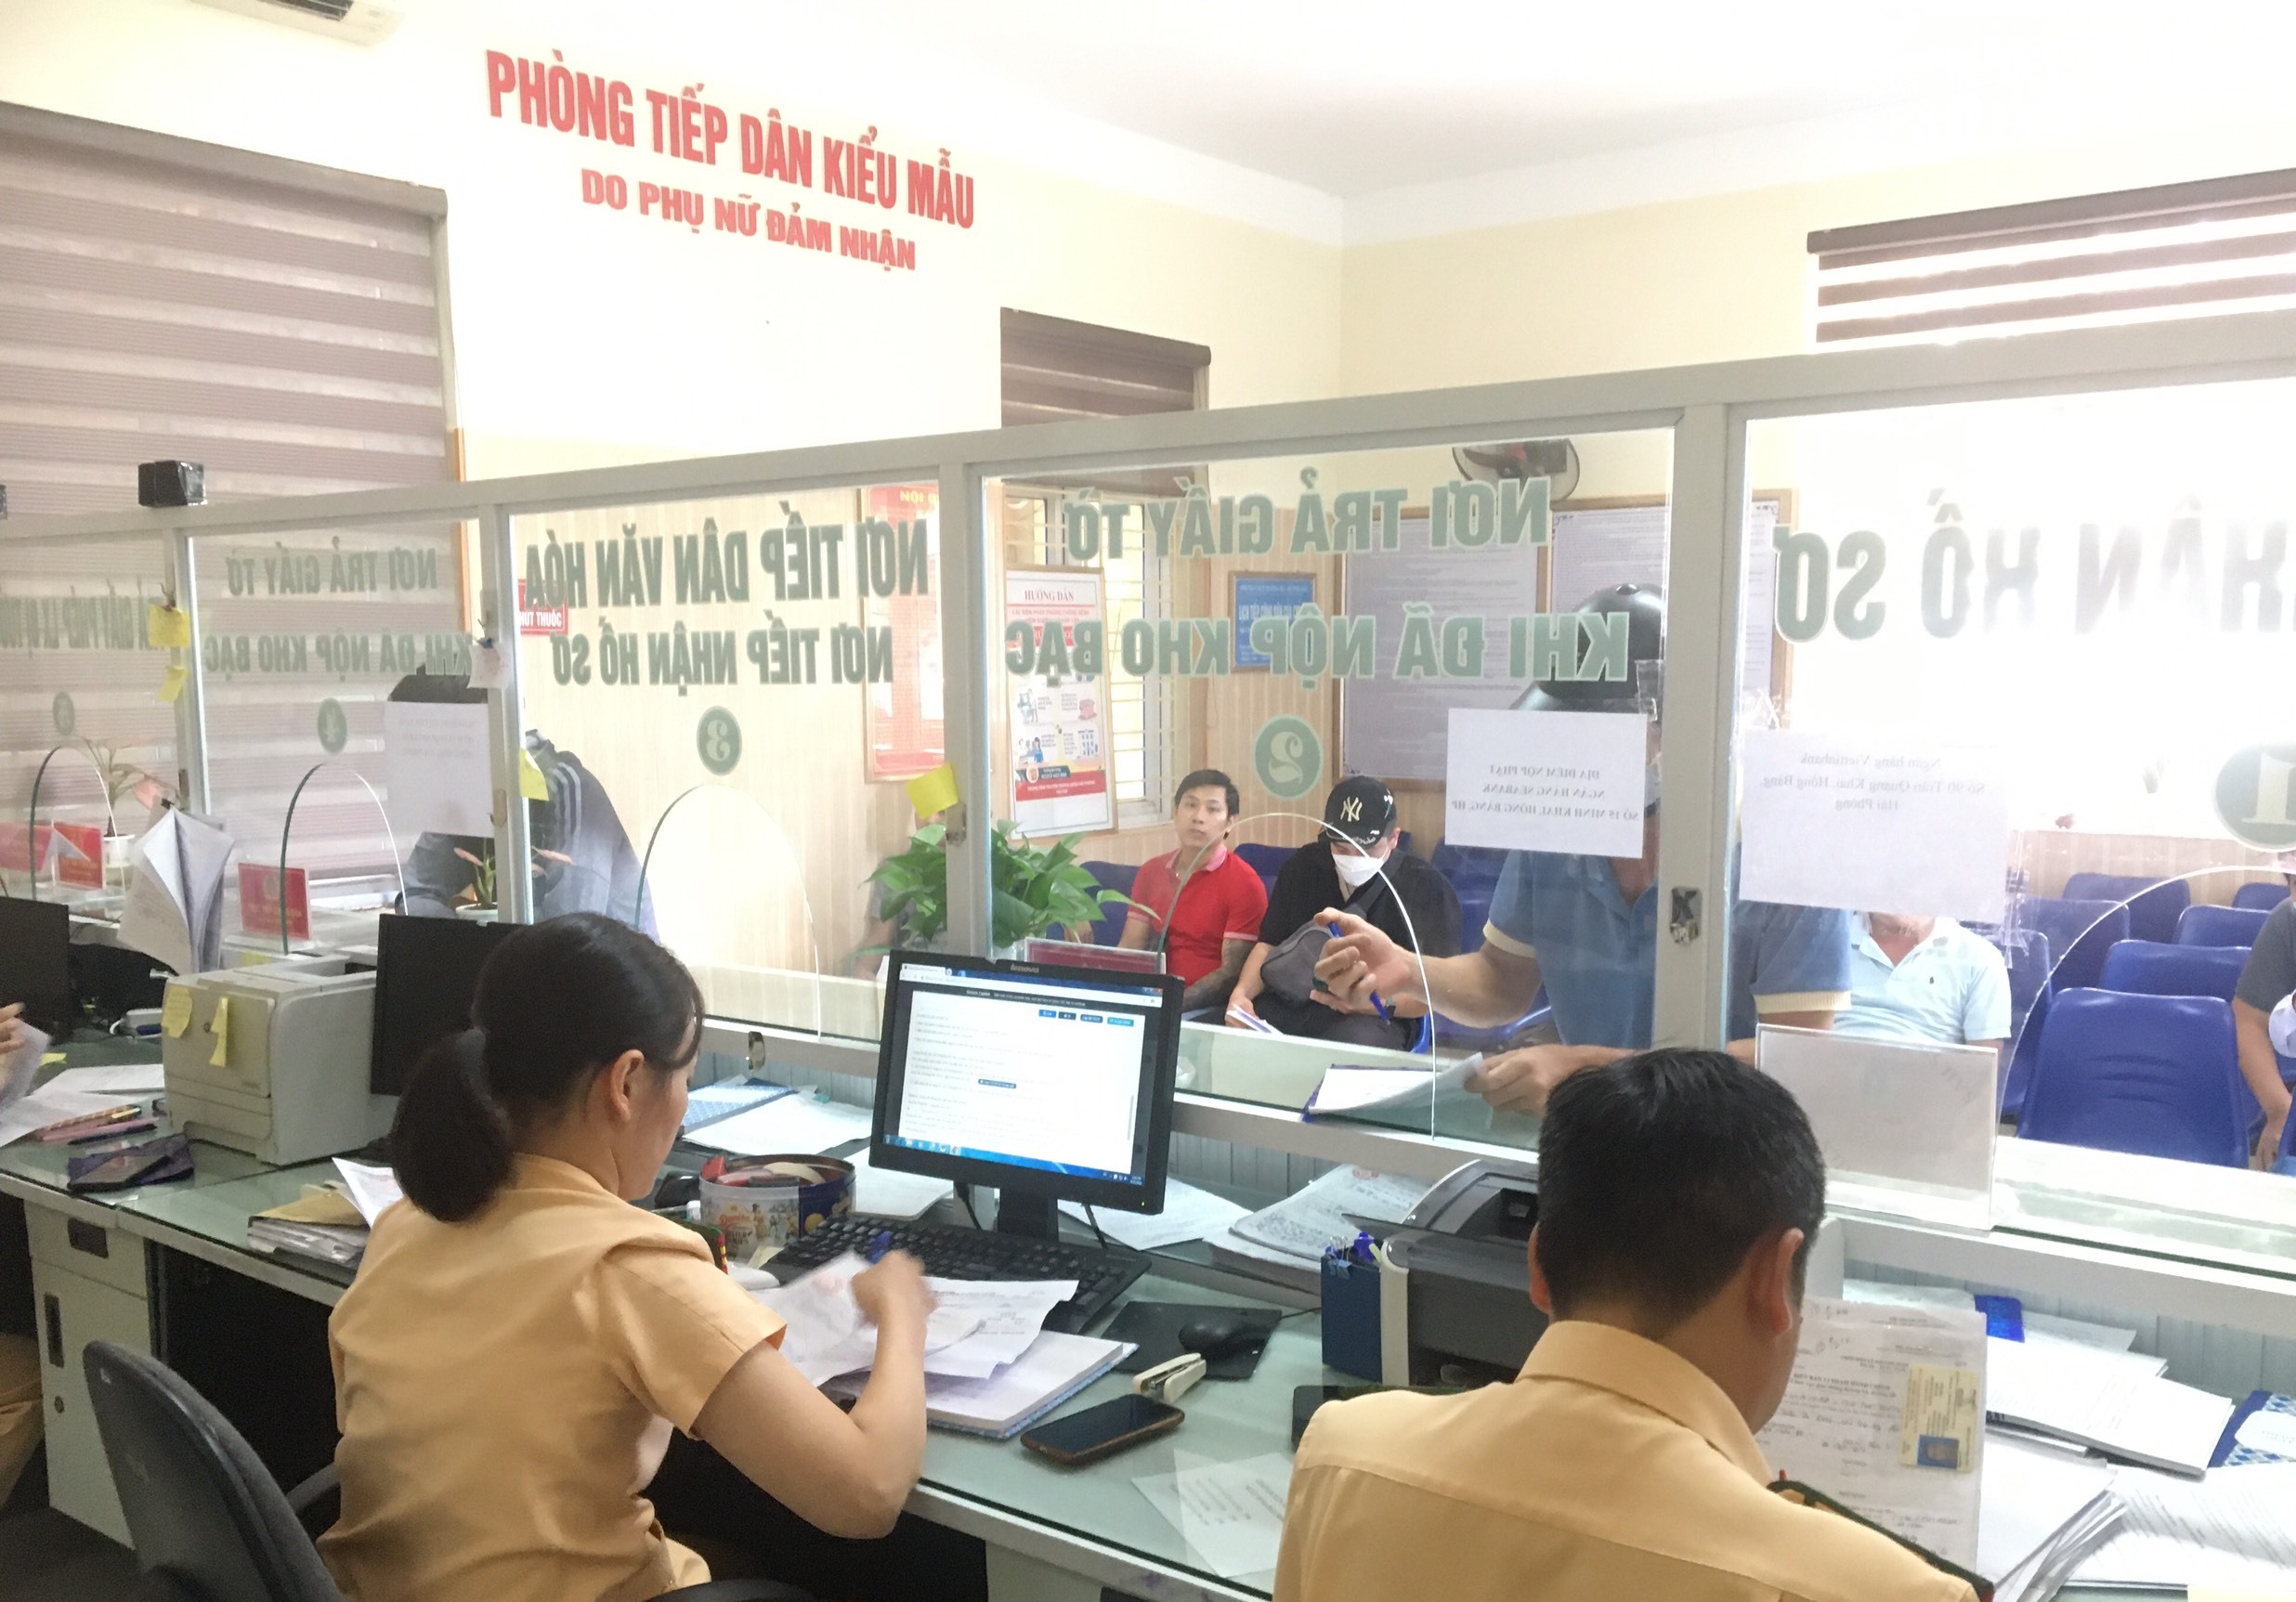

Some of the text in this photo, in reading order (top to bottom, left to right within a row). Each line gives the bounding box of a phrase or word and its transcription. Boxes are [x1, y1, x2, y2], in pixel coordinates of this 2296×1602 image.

[486, 48, 973, 228] PHÒNG TIẾP DÂN KIỂU MẪU
[581, 167, 916, 271] DO PHỤ NỮ ĐẢM NHẬN
